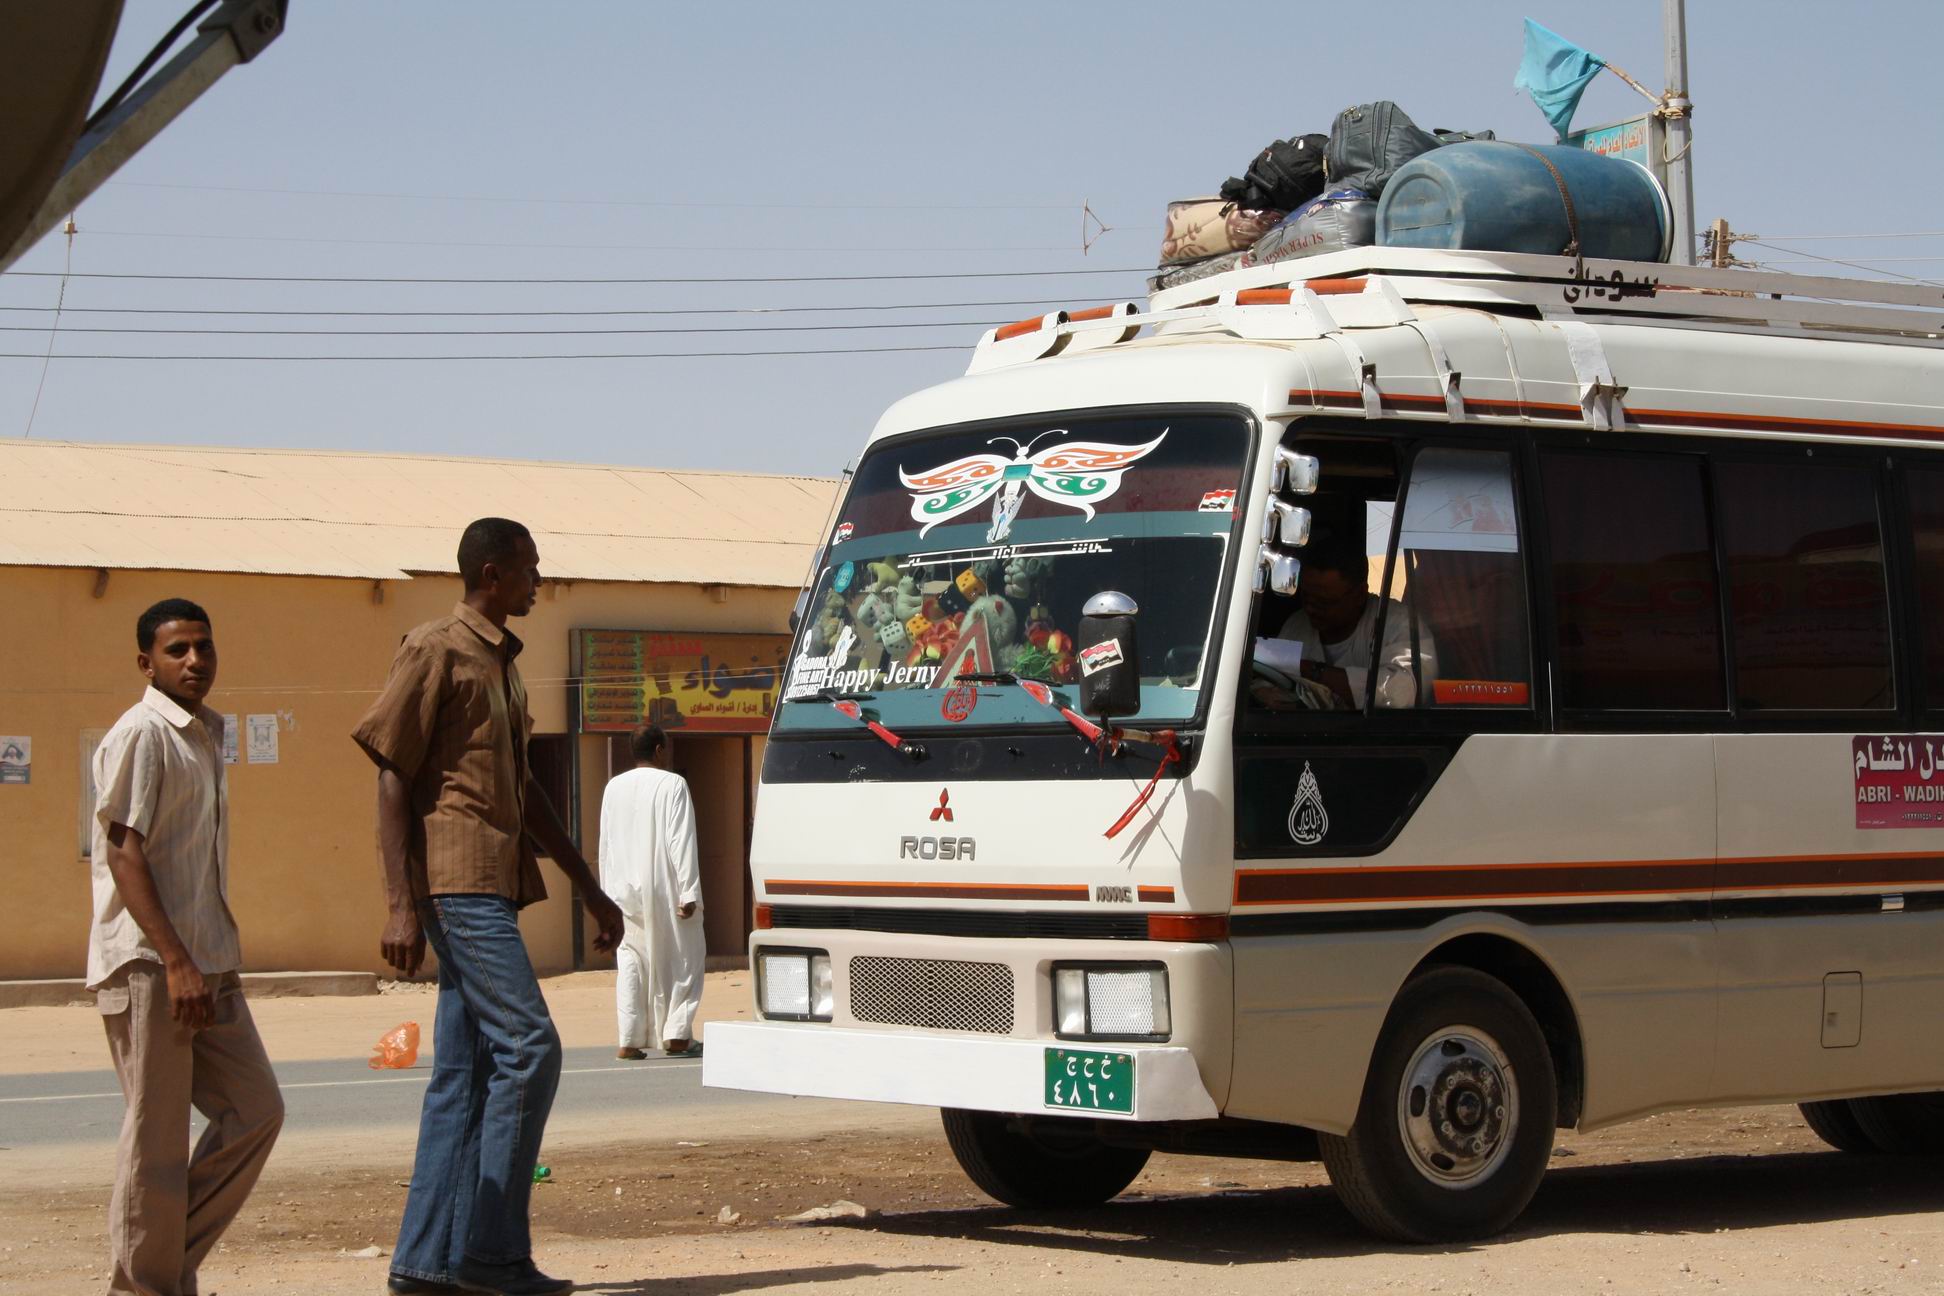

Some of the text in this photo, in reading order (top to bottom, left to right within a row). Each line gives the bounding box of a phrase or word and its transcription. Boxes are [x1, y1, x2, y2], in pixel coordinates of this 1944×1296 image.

[819, 660, 941, 694] Happy Jerny
[1858, 785, 1891, 802] ABRI
[900, 836, 976, 861] ROSA
[1053, 1079, 1115, 1107] ٤٨٦٠
